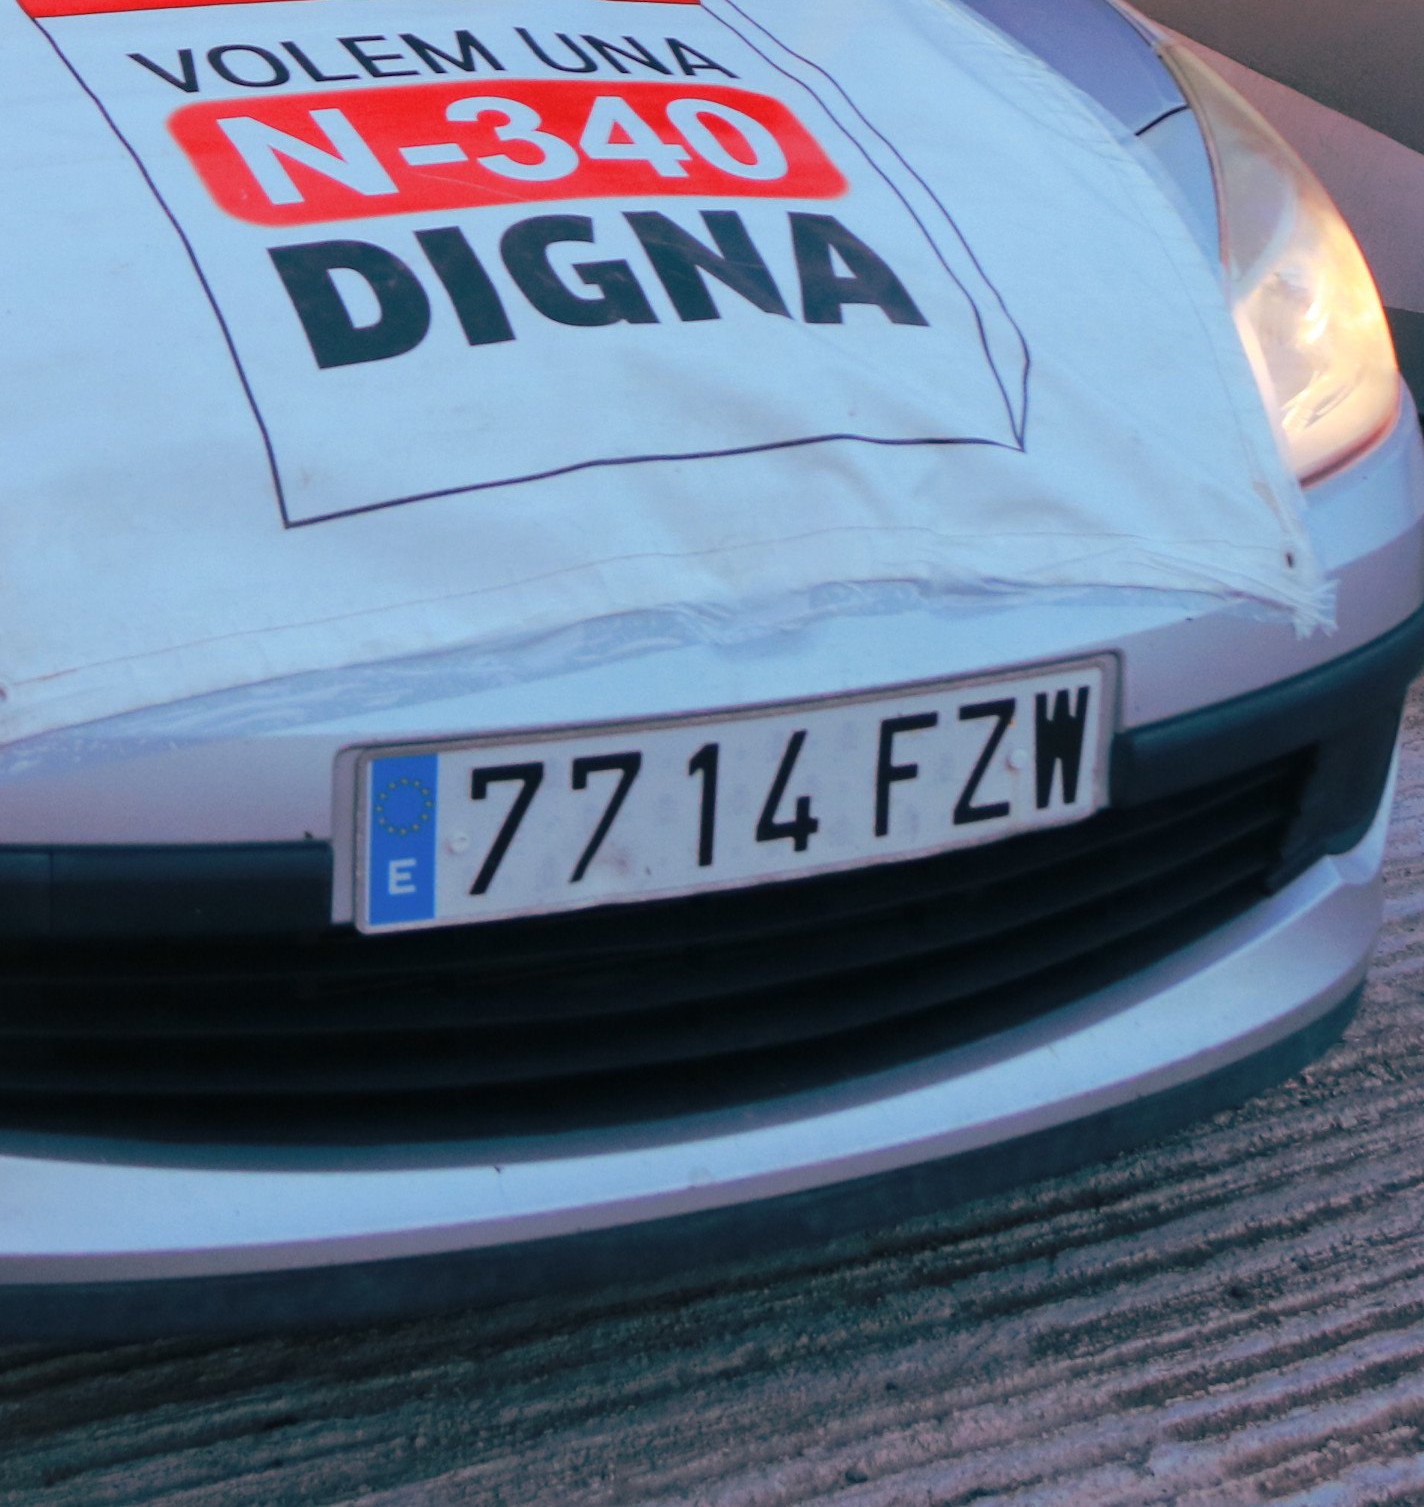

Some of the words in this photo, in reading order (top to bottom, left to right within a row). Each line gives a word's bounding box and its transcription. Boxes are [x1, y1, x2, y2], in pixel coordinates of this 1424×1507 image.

[129, 28, 506, 93] VOLEM
[515, 27, 739, 79] UNA
[216, 95, 789, 205] N-340
[268, 210, 930, 370] DIGNA
[468, 729, 819, 896] 7714
[874, 684, 1091, 838] FZW
[388, 857, 417, 894] E
